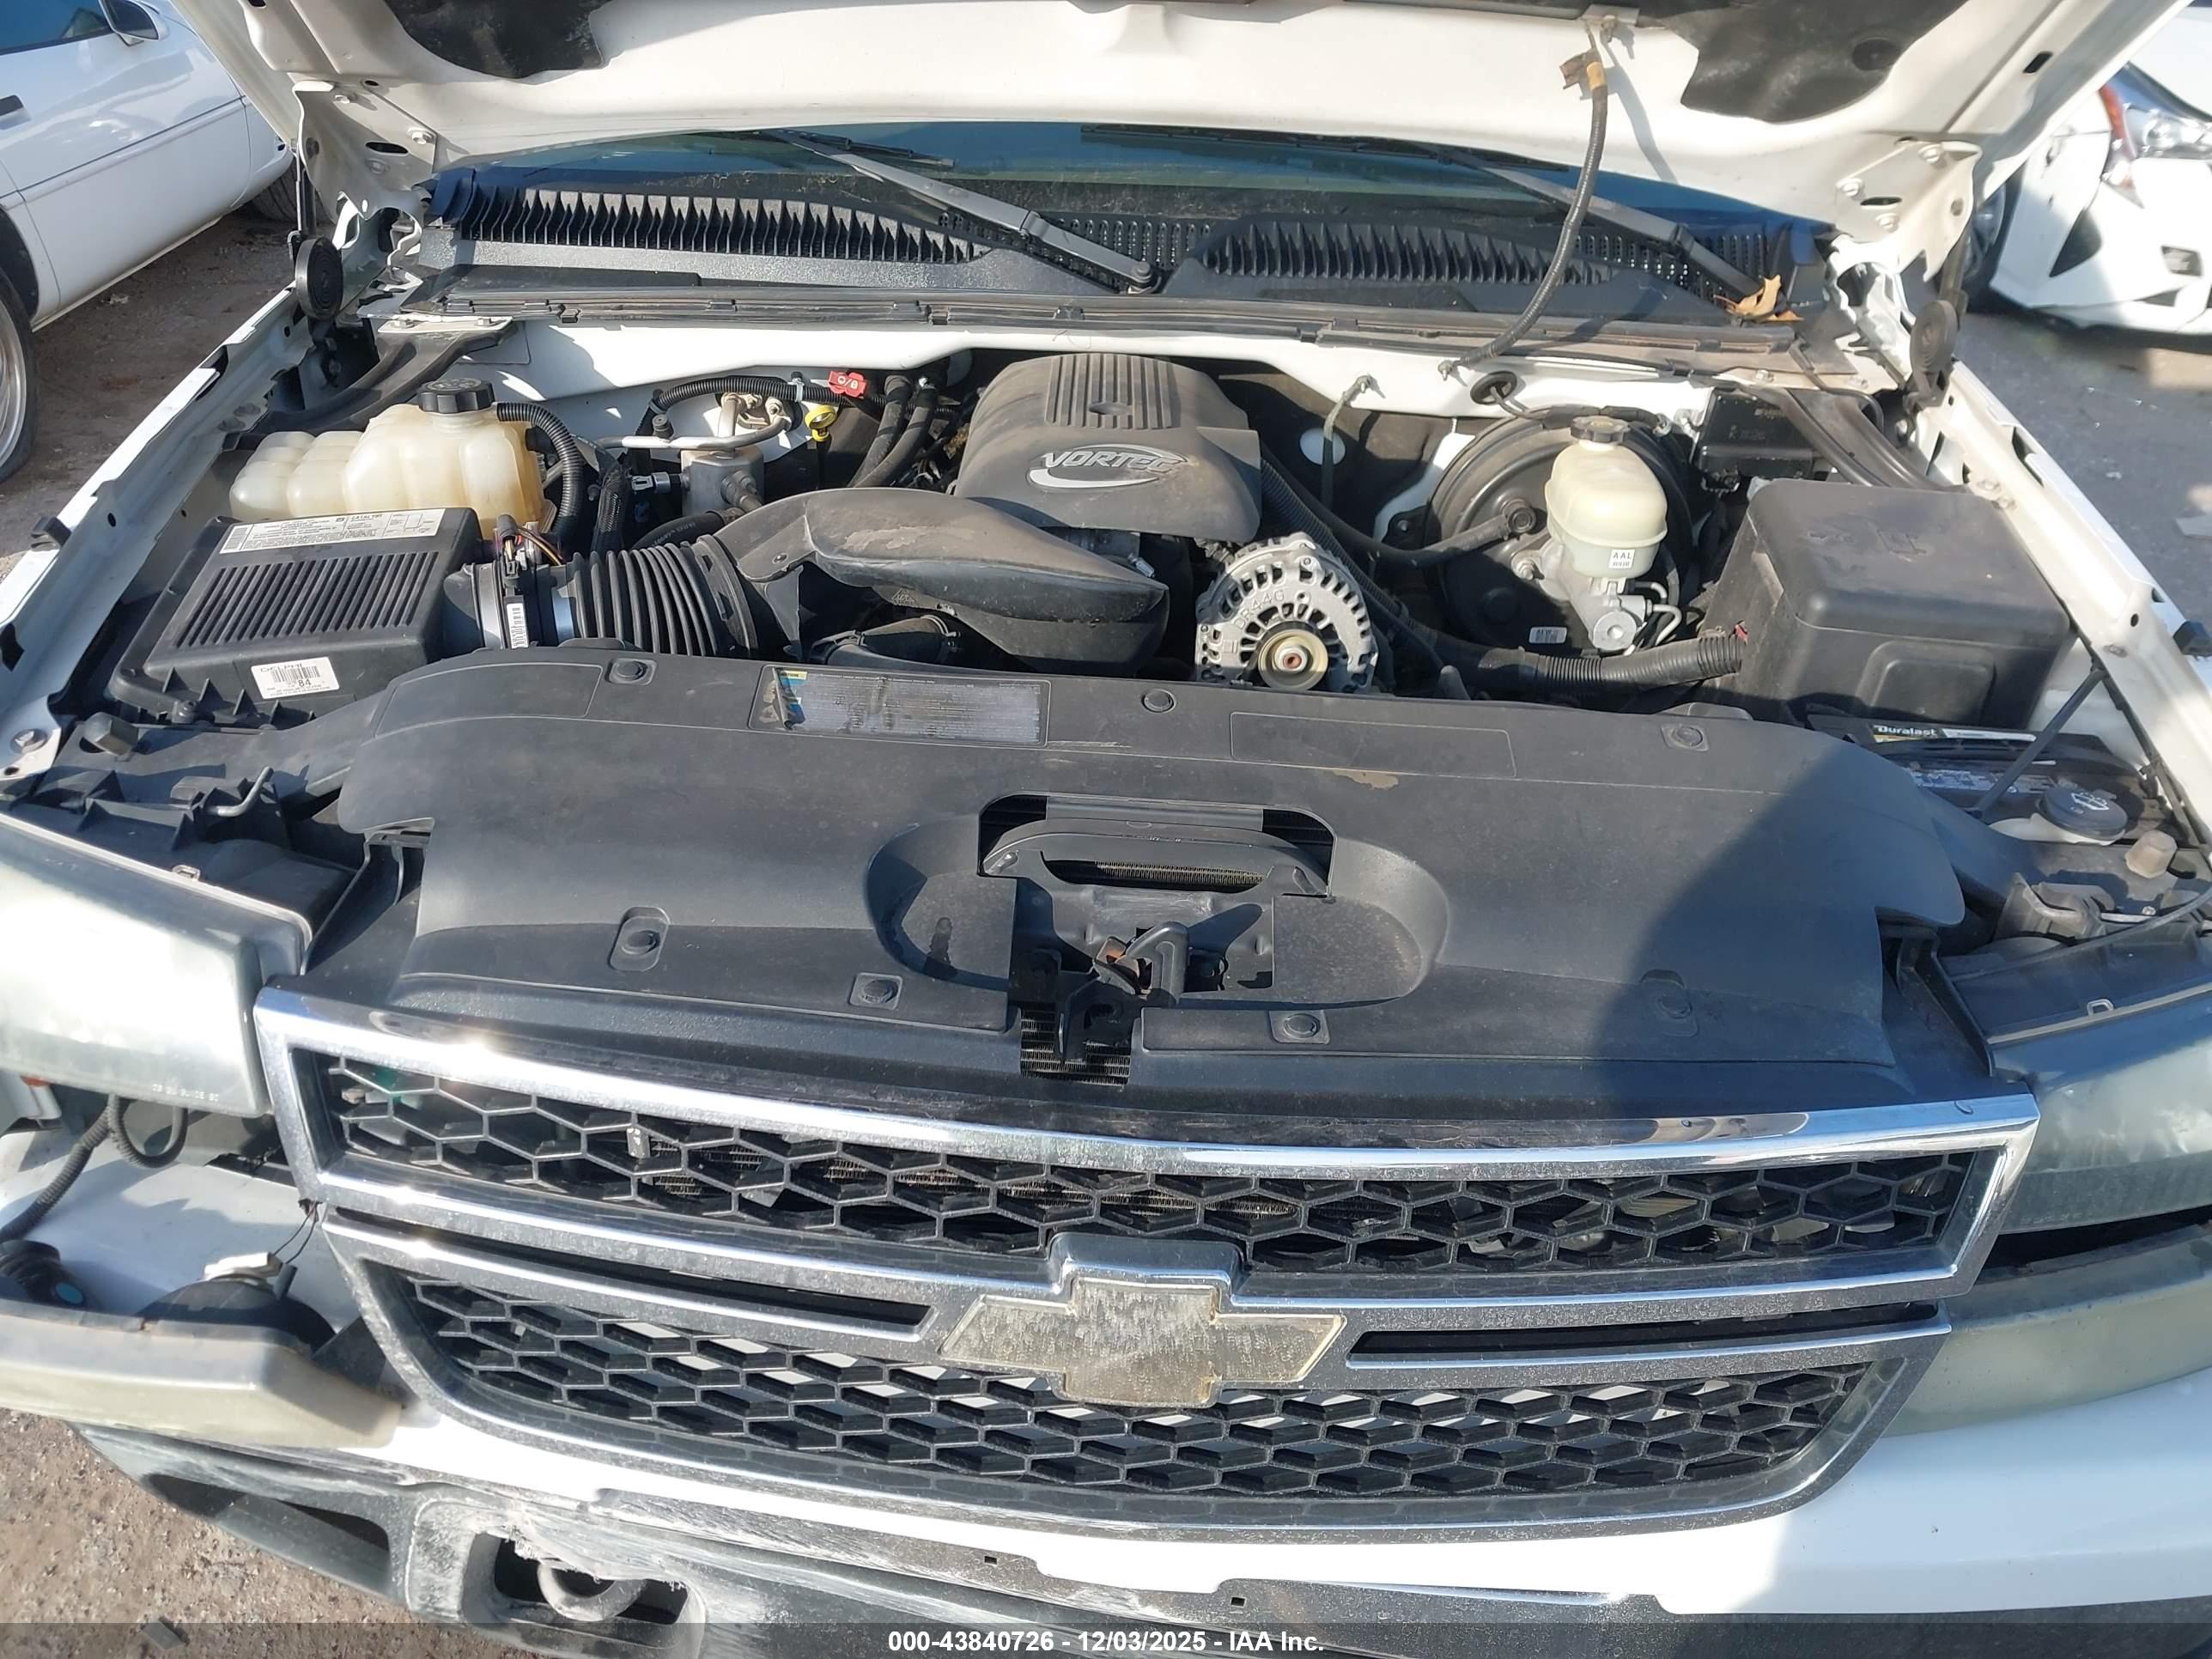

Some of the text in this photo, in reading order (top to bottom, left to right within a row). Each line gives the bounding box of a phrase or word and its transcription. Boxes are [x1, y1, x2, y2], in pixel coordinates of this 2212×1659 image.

[1041, 451, 1182, 473] VORTEC
[298, 678, 312, 687] 84
[1873, 725, 1938, 736] Duralast
